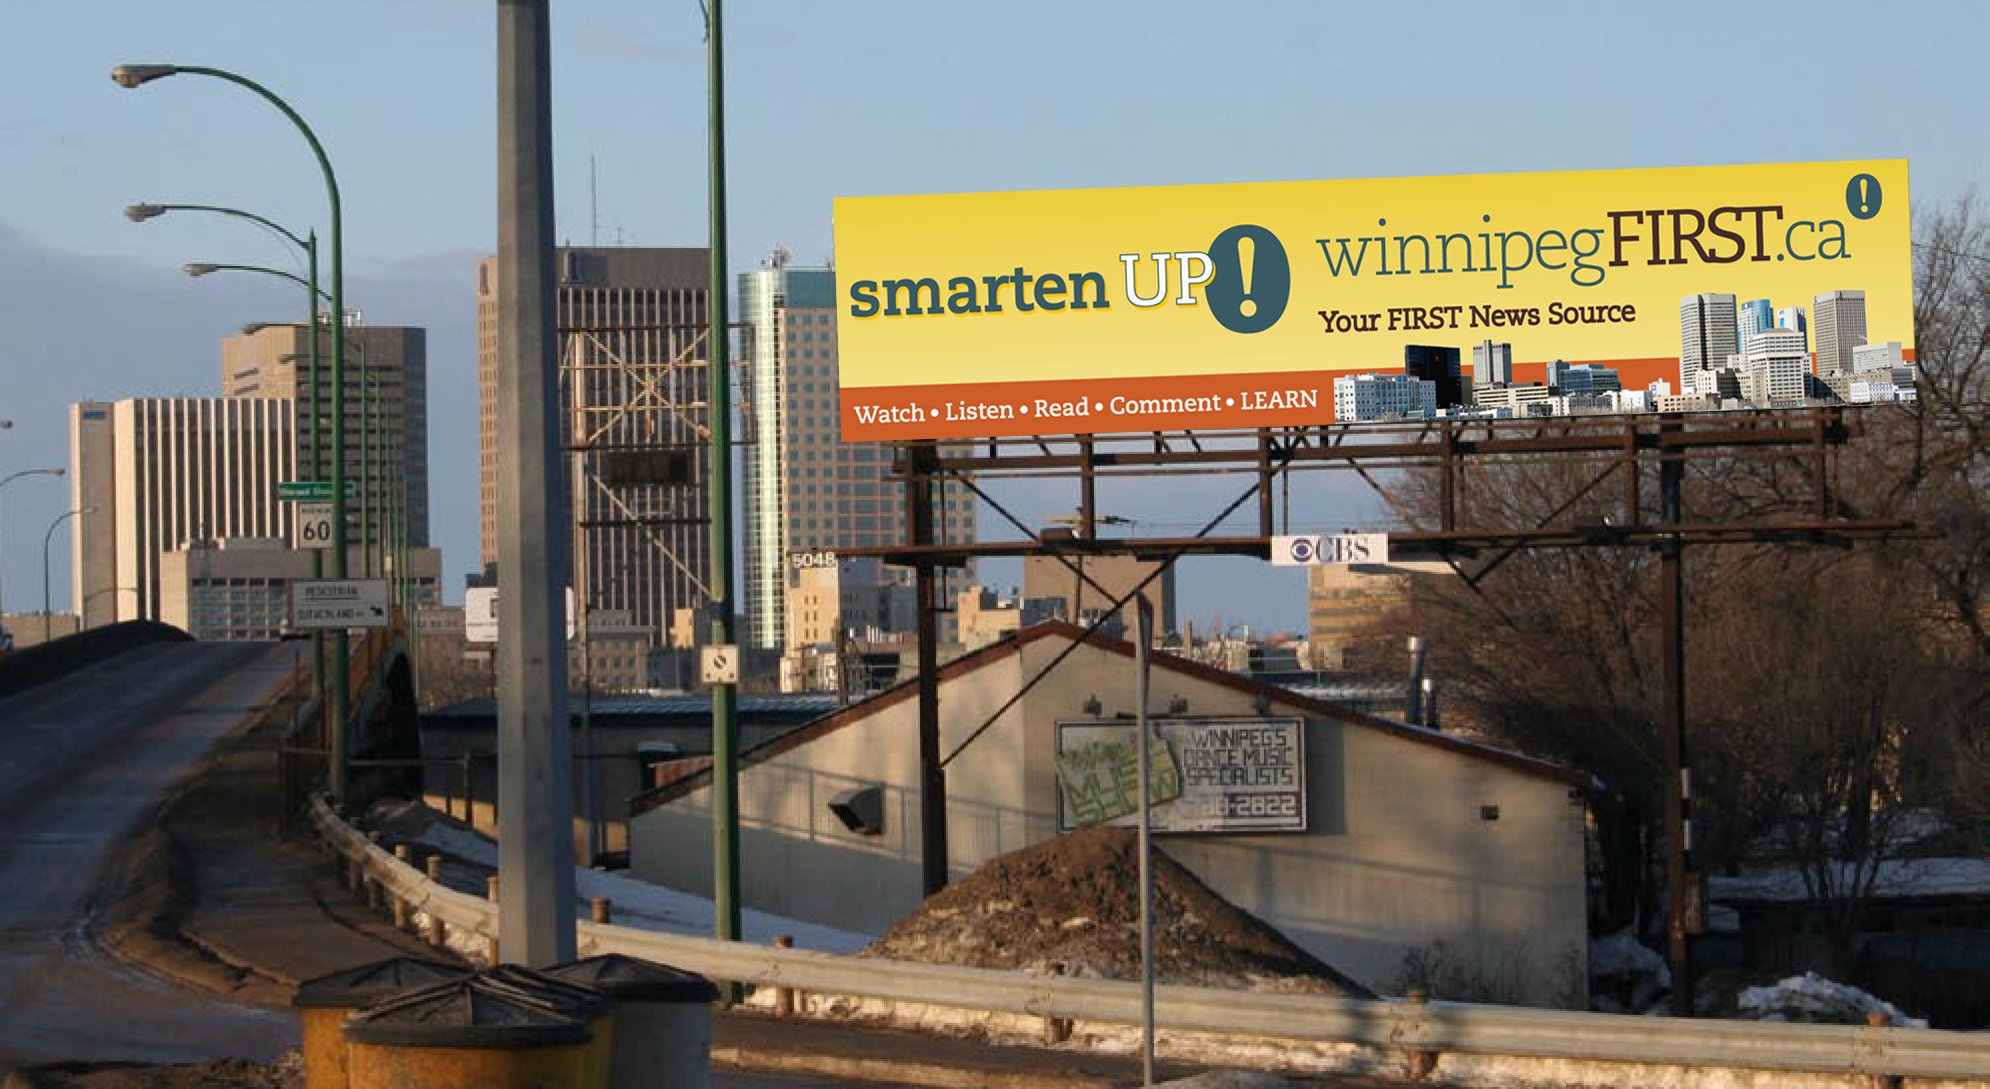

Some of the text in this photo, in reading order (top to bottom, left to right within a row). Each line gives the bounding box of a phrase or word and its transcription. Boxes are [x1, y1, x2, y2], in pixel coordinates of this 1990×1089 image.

[1316, 205, 1852, 289] winnipegFIRST.ca
[849, 266, 1109, 318] smarten
[1318, 301, 1637, 334] Your FIRST News Source
[853, 388, 1318, 424] Watch Listen Read Comment LEARN
[303, 521, 331, 541] 60
[792, 551, 836, 568] 5048
[1315, 536, 1370, 562] CBS
[1244, 746, 1294, 766] MUSIC
